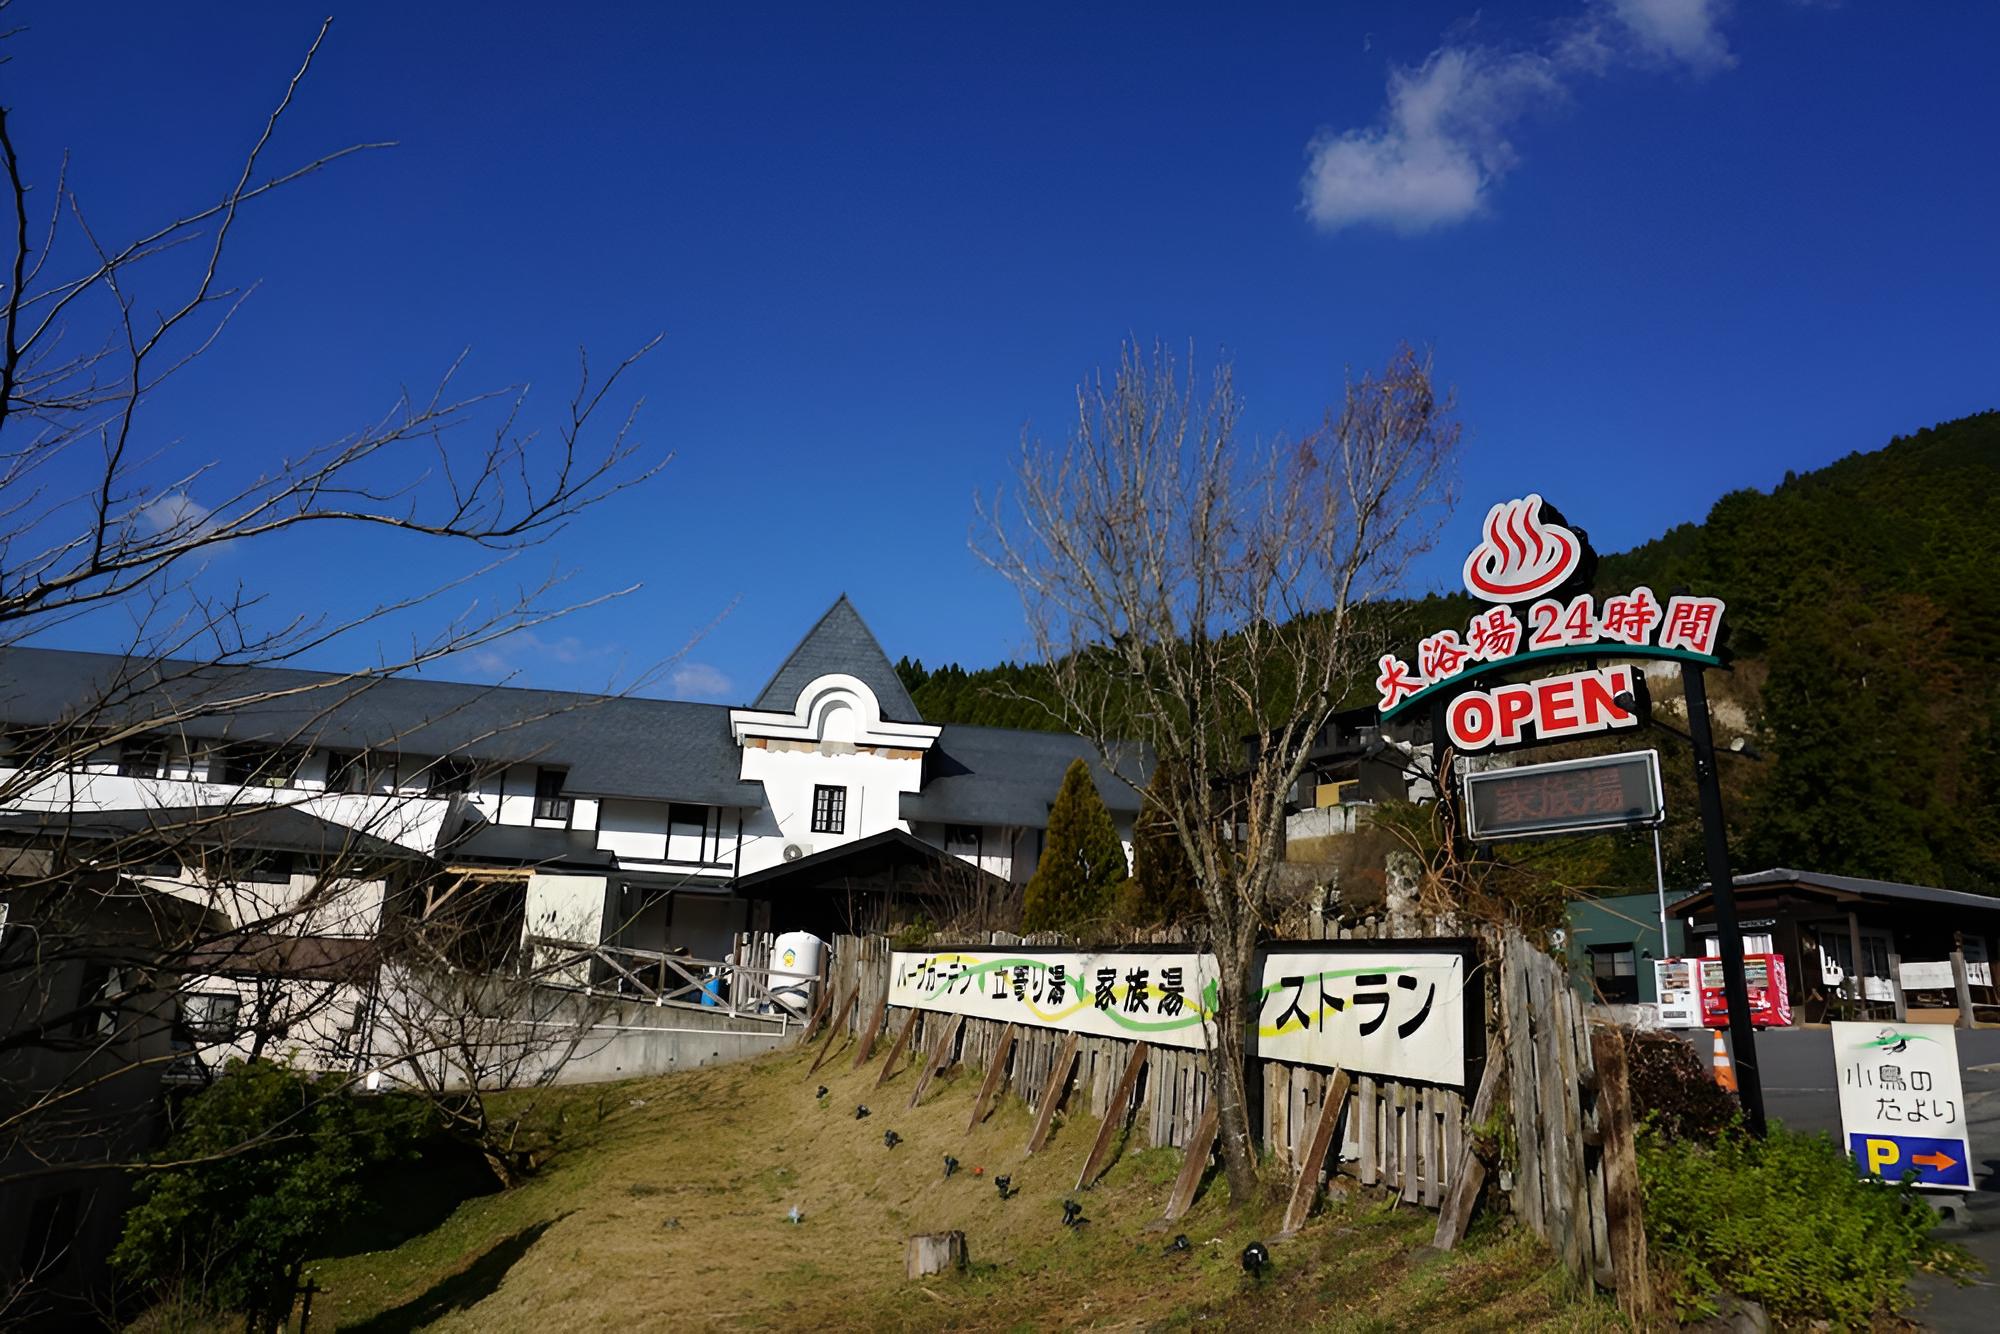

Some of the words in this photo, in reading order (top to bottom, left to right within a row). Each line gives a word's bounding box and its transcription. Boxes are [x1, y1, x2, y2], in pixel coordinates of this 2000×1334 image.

[1379, 590, 1720, 709] 大浴場24時間
[1450, 669, 1632, 745] OPEN
[1094, 966, 1185, 1016] 家族湯
[1258, 972, 1435, 1039] ストラン
[1876, 1098, 1956, 1124] たより
[1866, 1138, 1900, 1175] P
